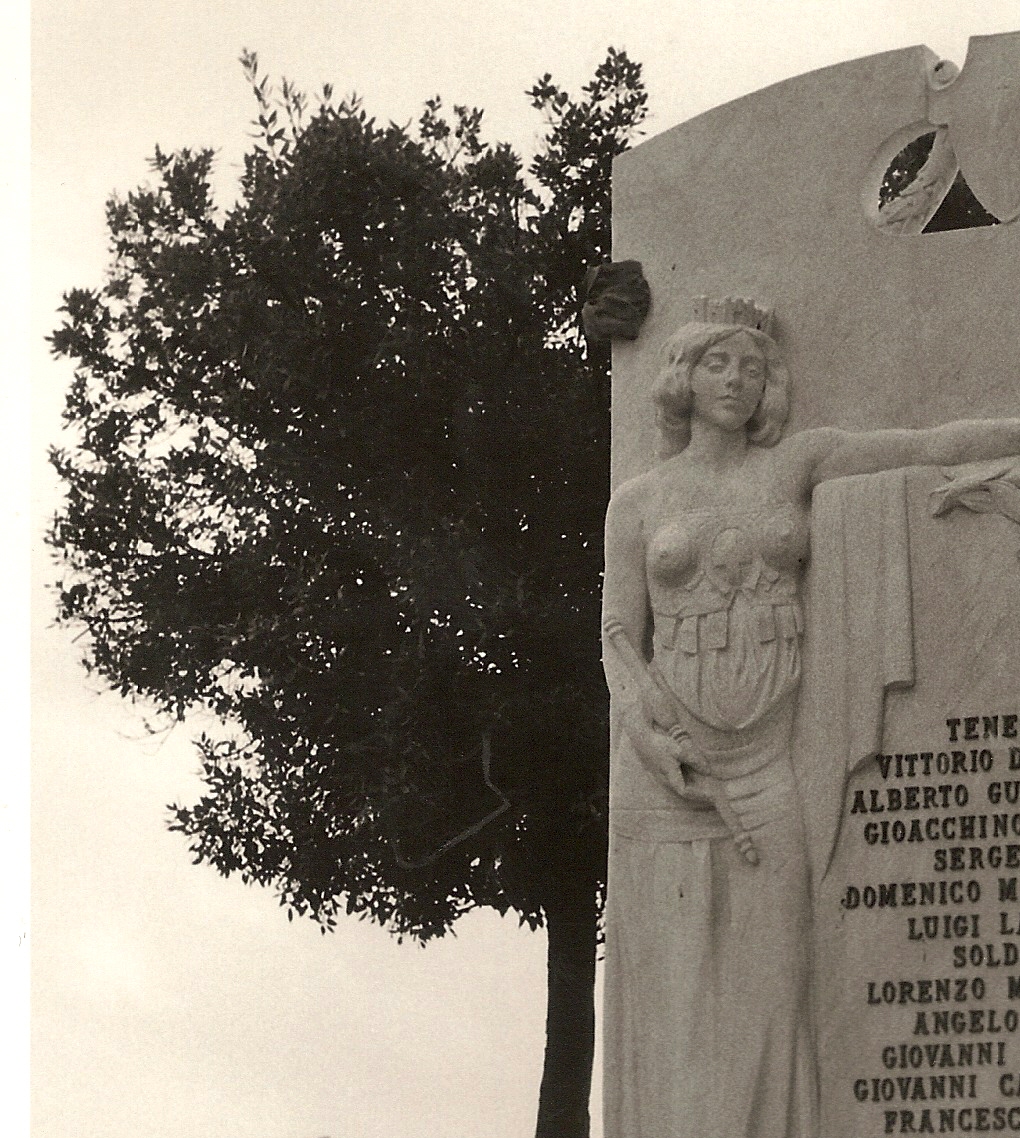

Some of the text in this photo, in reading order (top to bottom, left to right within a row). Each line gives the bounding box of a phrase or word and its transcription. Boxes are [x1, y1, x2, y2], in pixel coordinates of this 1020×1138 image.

[875, 749, 993, 779] VITTORIO
[851, 784, 969, 814] ALBERTO
[844, 880, 981, 909] DOMENICO
[908, 914, 980, 940] LUIGI
[867, 978, 985, 1004] LORENZO
[914, 1009, 1018, 1035] ANGELO
[882, 1042, 1005, 1069] GIOVANNI
[854, 1075, 977, 1102] GIOVANNI
